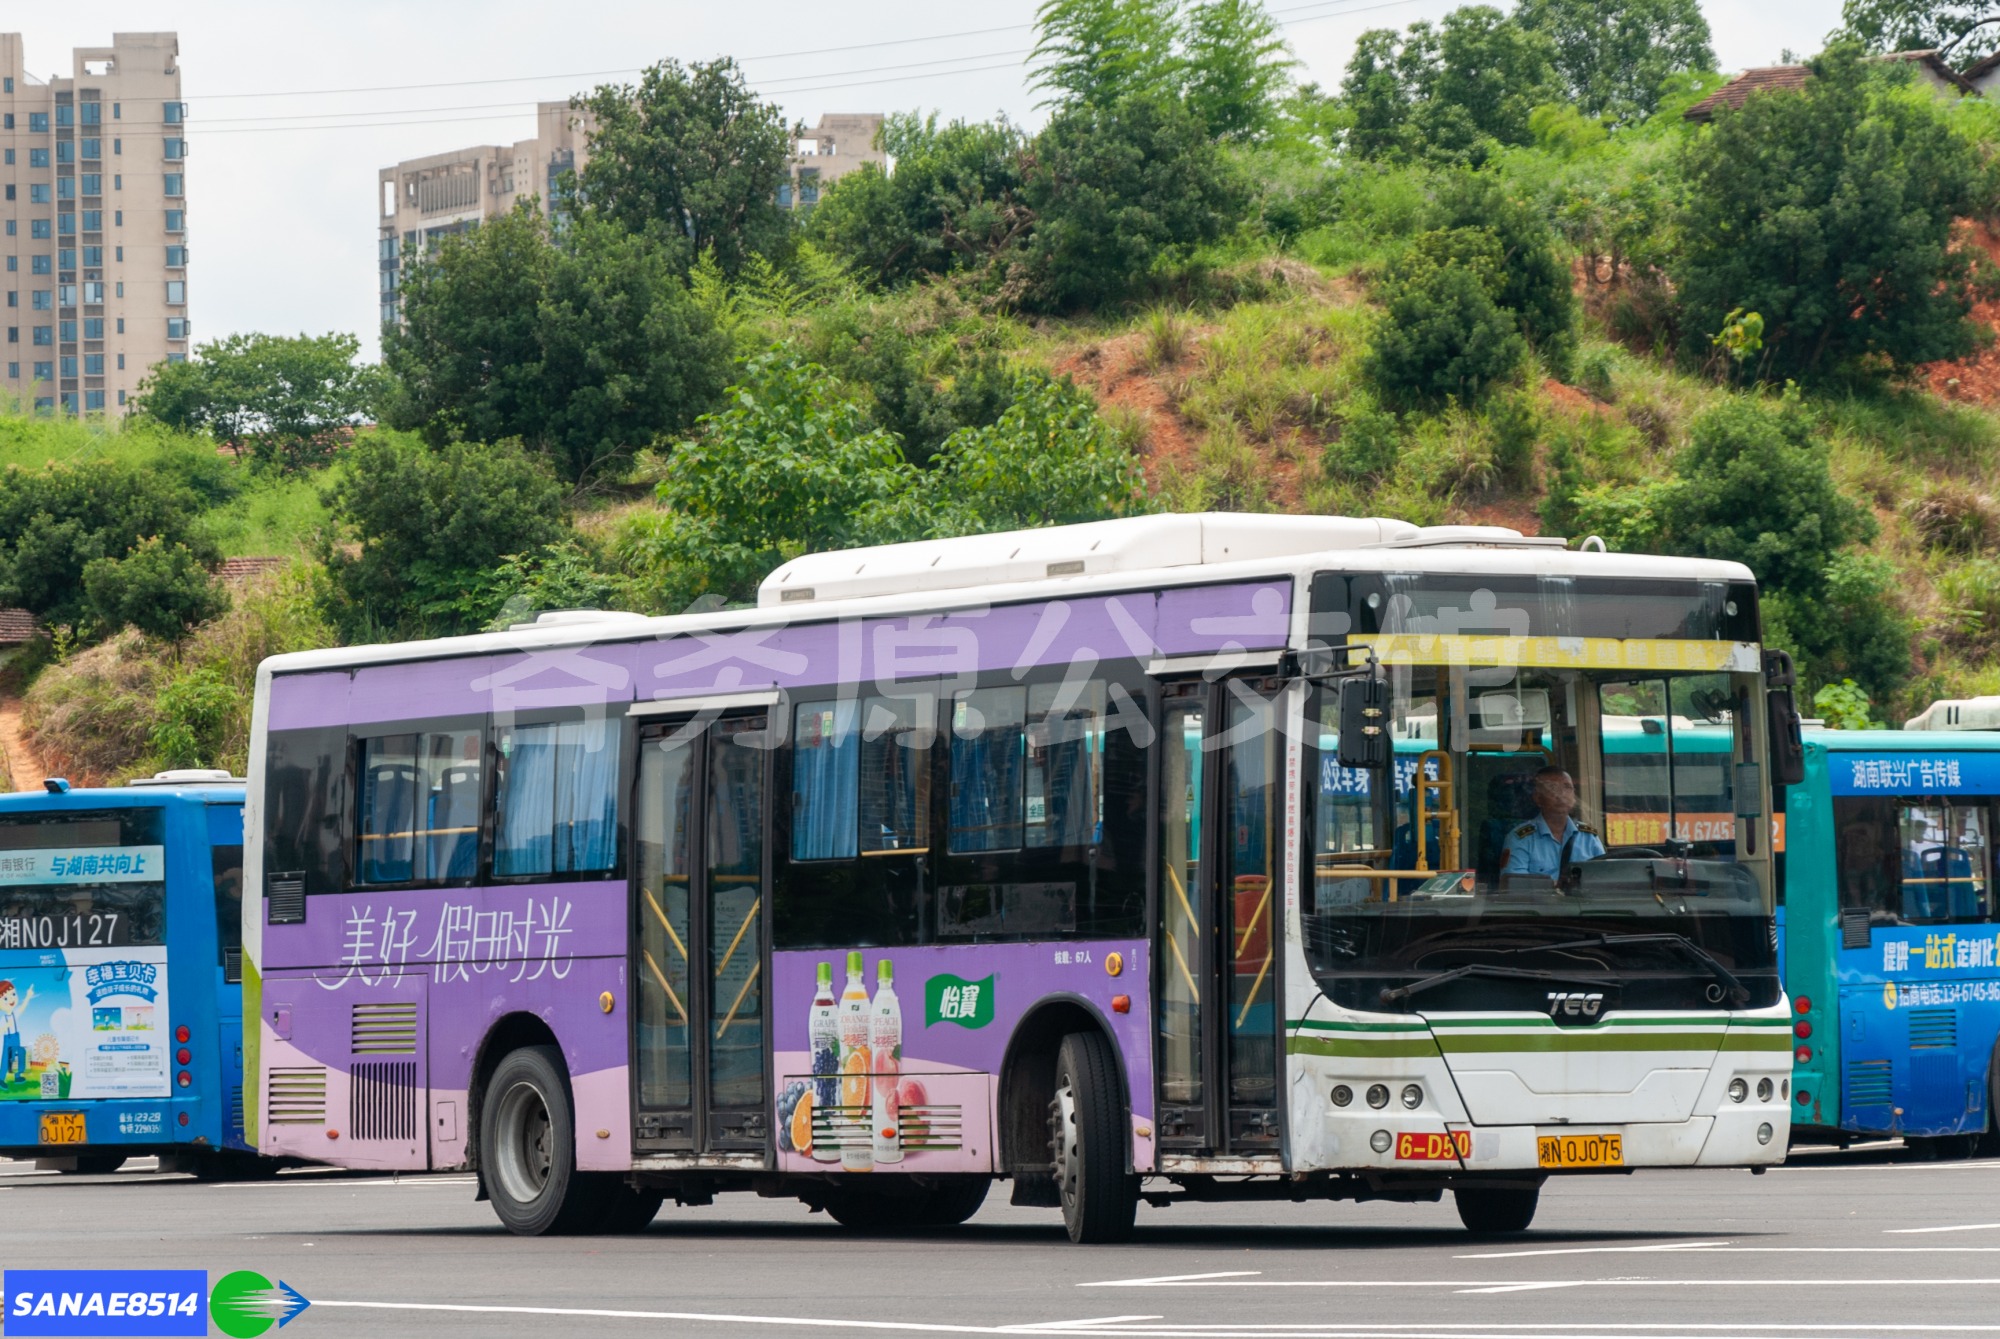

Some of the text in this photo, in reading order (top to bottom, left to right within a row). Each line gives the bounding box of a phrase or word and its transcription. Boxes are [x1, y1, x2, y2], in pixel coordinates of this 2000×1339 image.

[1851, 759, 1962, 788] 湖南联兴广告传媒
[1694, 821, 1729, 841] 6745
[0, 857, 36, 872] 南银行
[50, 853, 146, 876] 与湖南共向上
[0, 914, 118, 948] 湘N0J127
[87, 963, 155, 984] 幸福宝贝卡
[939, 985, 980, 1019] 怡寶
[1546, 992, 1604, 1016] TEG
[814, 1019, 837, 1028] GRAPE
[841, 1015, 870, 1024] ORANGE
[874, 1017, 898, 1026] PEACH
[41, 1126, 83, 1142] 0J127
[1400, 1132, 1469, 1159] 6-D50
